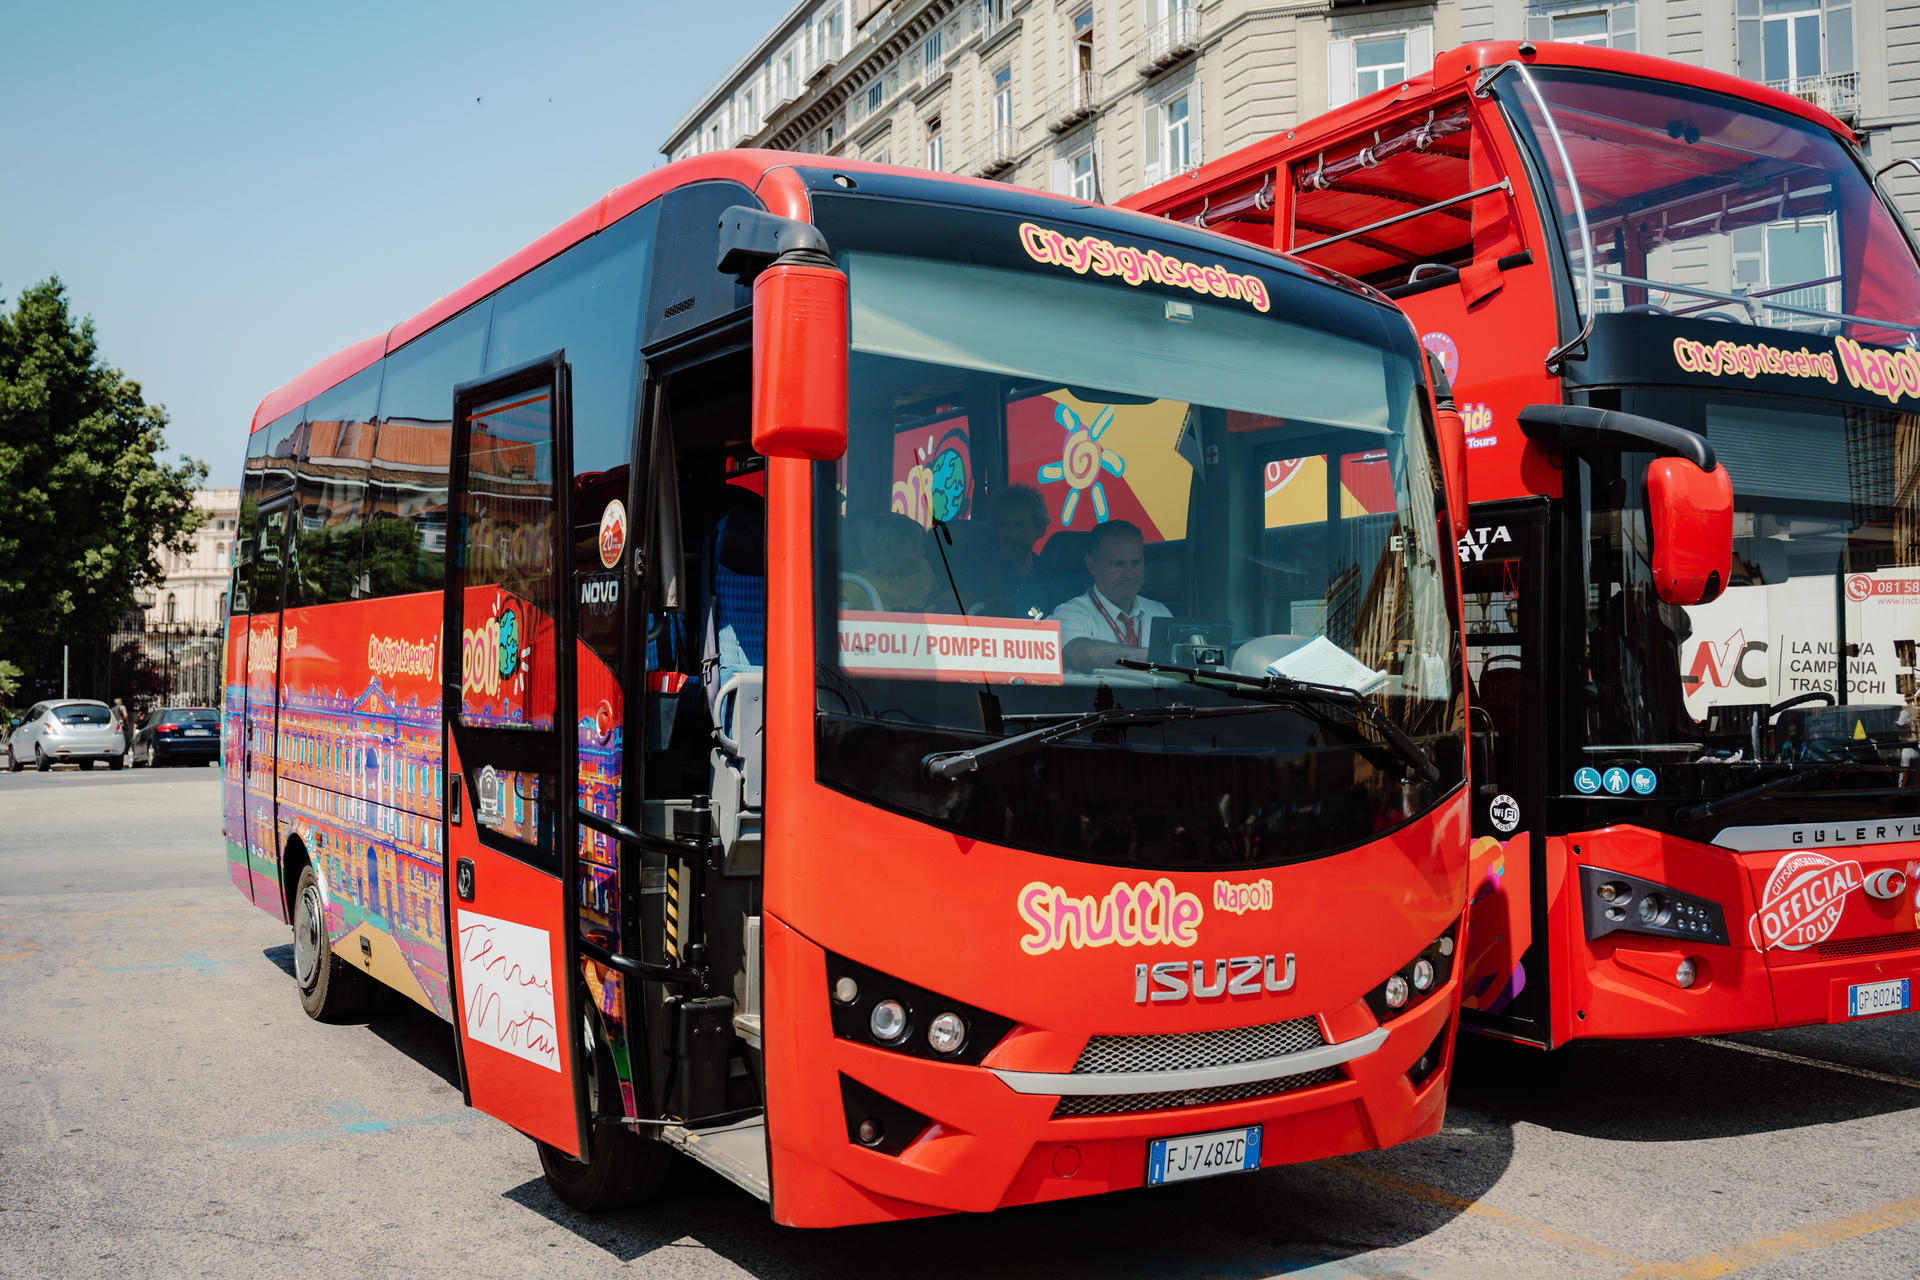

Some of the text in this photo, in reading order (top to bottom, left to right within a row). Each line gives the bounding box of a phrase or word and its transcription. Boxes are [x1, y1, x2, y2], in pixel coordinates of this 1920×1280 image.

[1019, 223, 1271, 313] CitySightseeing
[1673, 337, 1838, 385] CitySightseeing
[1467, 437, 1497, 448] Tours
[581, 581, 619, 604] NOVO
[368, 633, 435, 682] CitySightseeing
[838, 632, 907, 654] NAPOLI
[926, 636, 998, 658] POMPEI
[1003, 640, 1057, 661] RUINS
[1792, 642, 1812, 654] LA
[1790, 660, 1877, 675] CAMPNIA
[1495, 795, 1516, 808] FREE
[1018, 878, 1274, 956] Shuttle Napoli
[1762, 866, 1858, 940] OFFICIAL
[1797, 906, 1839, 943] TOUR
[1135, 953, 1296, 1003] ISUZU
